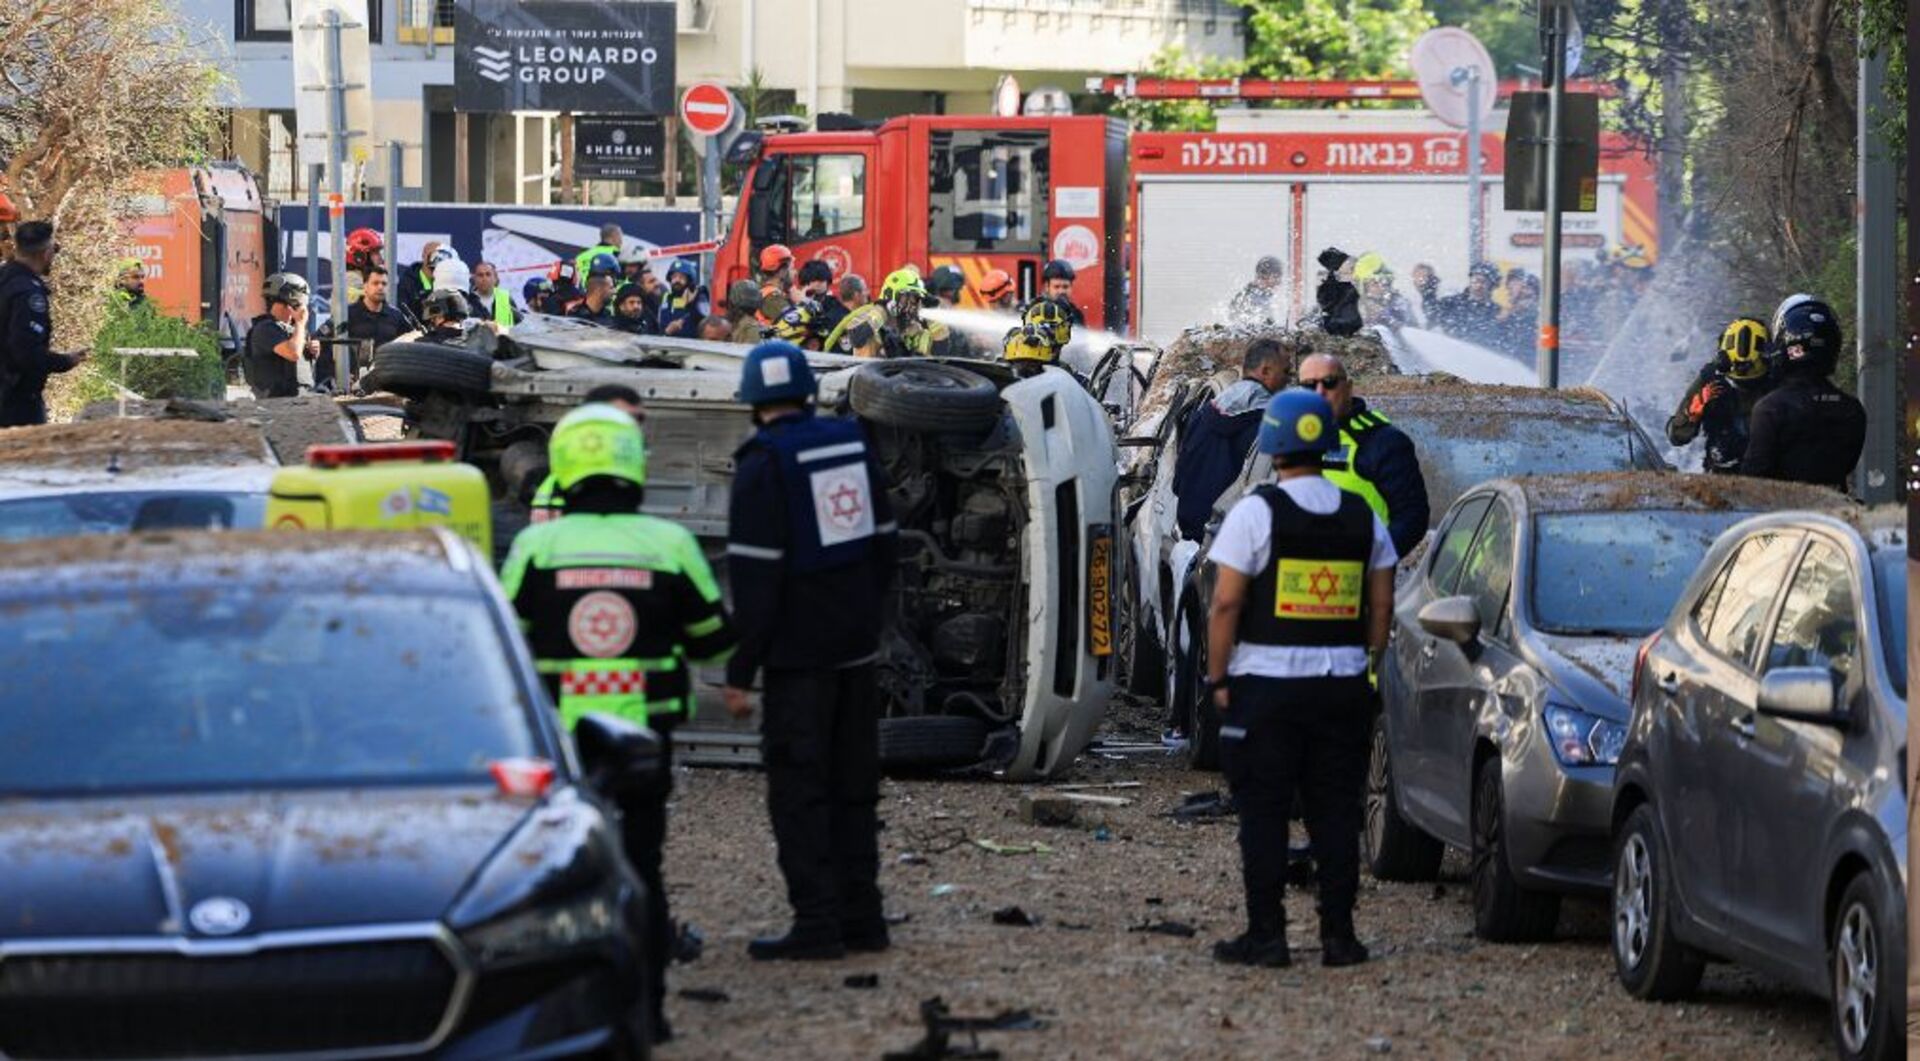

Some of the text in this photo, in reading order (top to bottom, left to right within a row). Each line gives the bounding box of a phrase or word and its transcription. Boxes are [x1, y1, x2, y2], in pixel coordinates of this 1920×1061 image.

[519, 46, 658, 64] LEONARDO
[519, 66, 606, 84] GROUP
[585, 144, 652, 156] SHEMESH
[1181, 138, 1268, 167] והצלה
[1325, 141, 1414, 167] כבאות
